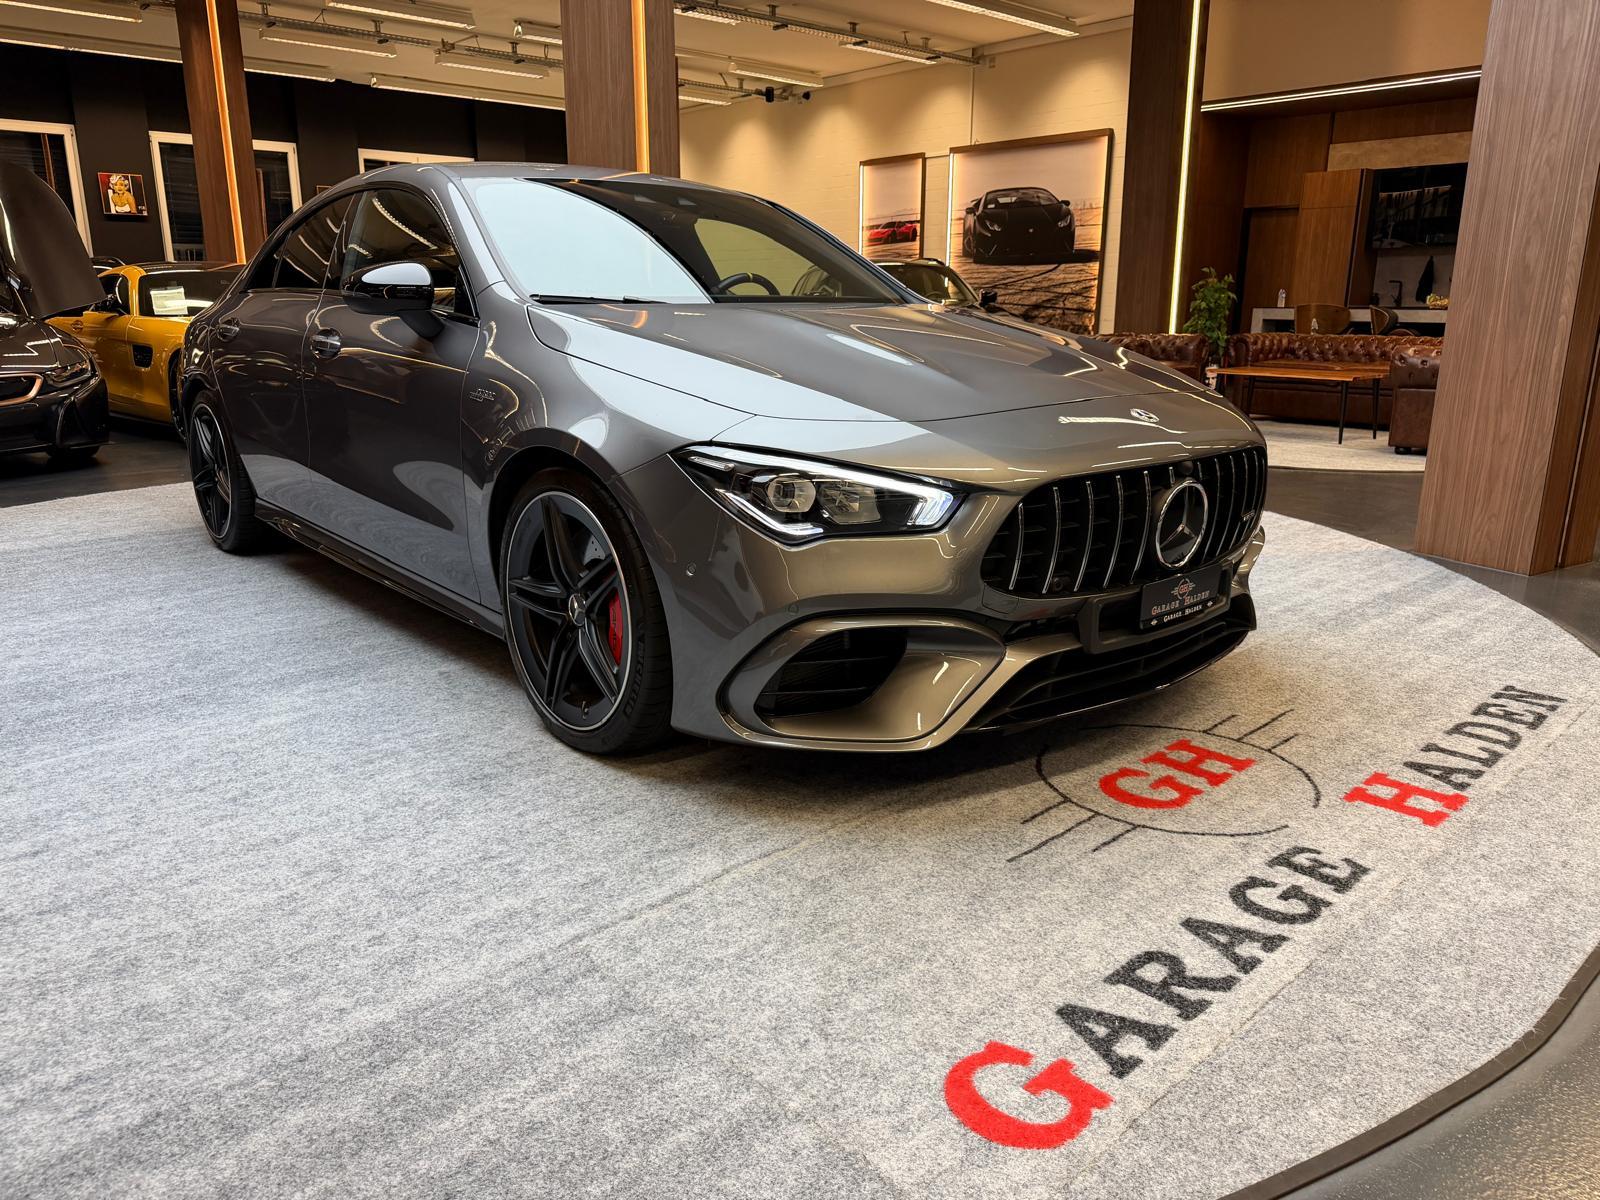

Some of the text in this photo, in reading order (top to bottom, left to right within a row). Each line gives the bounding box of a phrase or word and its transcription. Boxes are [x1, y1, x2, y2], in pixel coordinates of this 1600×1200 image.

[1151, 590, 1210, 616] GARAGE HALDEN
[1099, 739, 1257, 810] GH
[944, 685, 1568, 1150] GARAGE HALDEN
